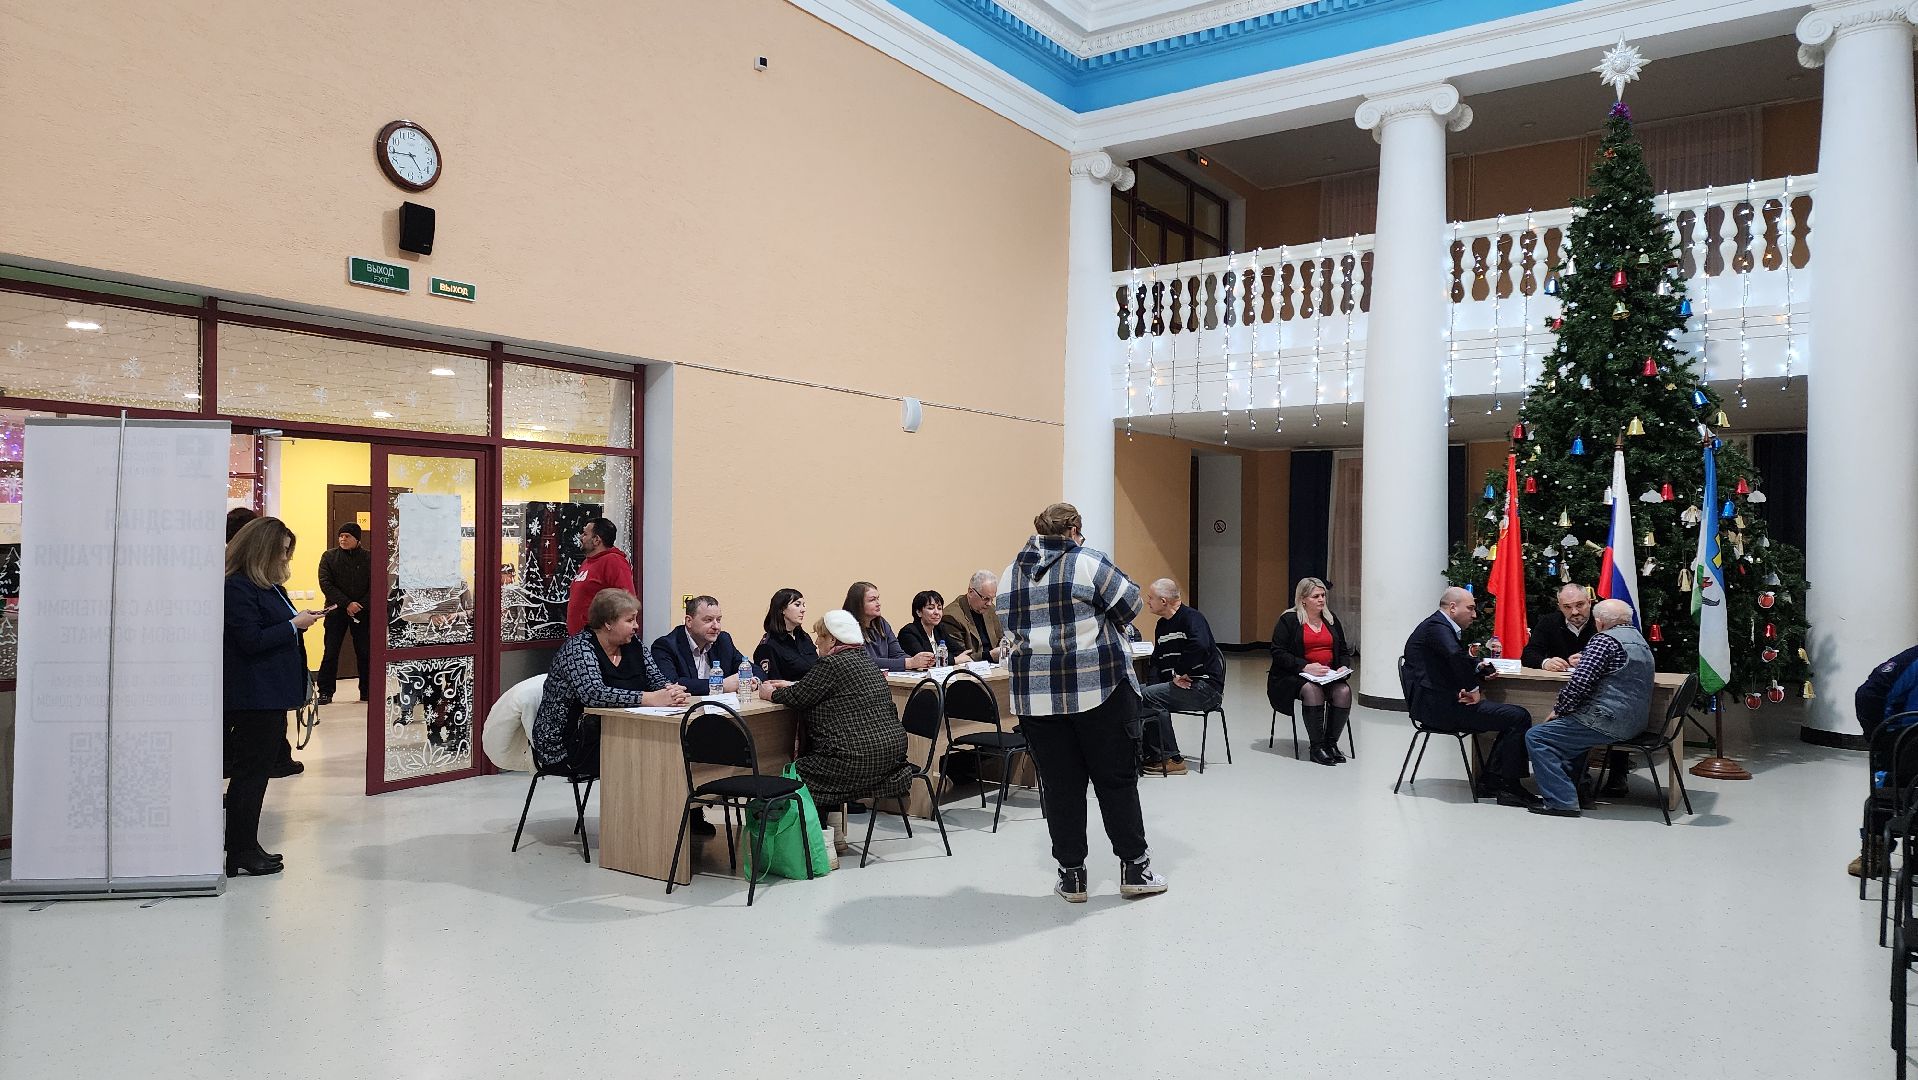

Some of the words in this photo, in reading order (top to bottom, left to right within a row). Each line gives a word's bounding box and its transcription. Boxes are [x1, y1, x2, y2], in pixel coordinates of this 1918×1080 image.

[366, 263, 395, 278] ВЫХОД
[373, 275, 389, 284] EXIT
[439, 282, 469, 296] ВЫХОД
